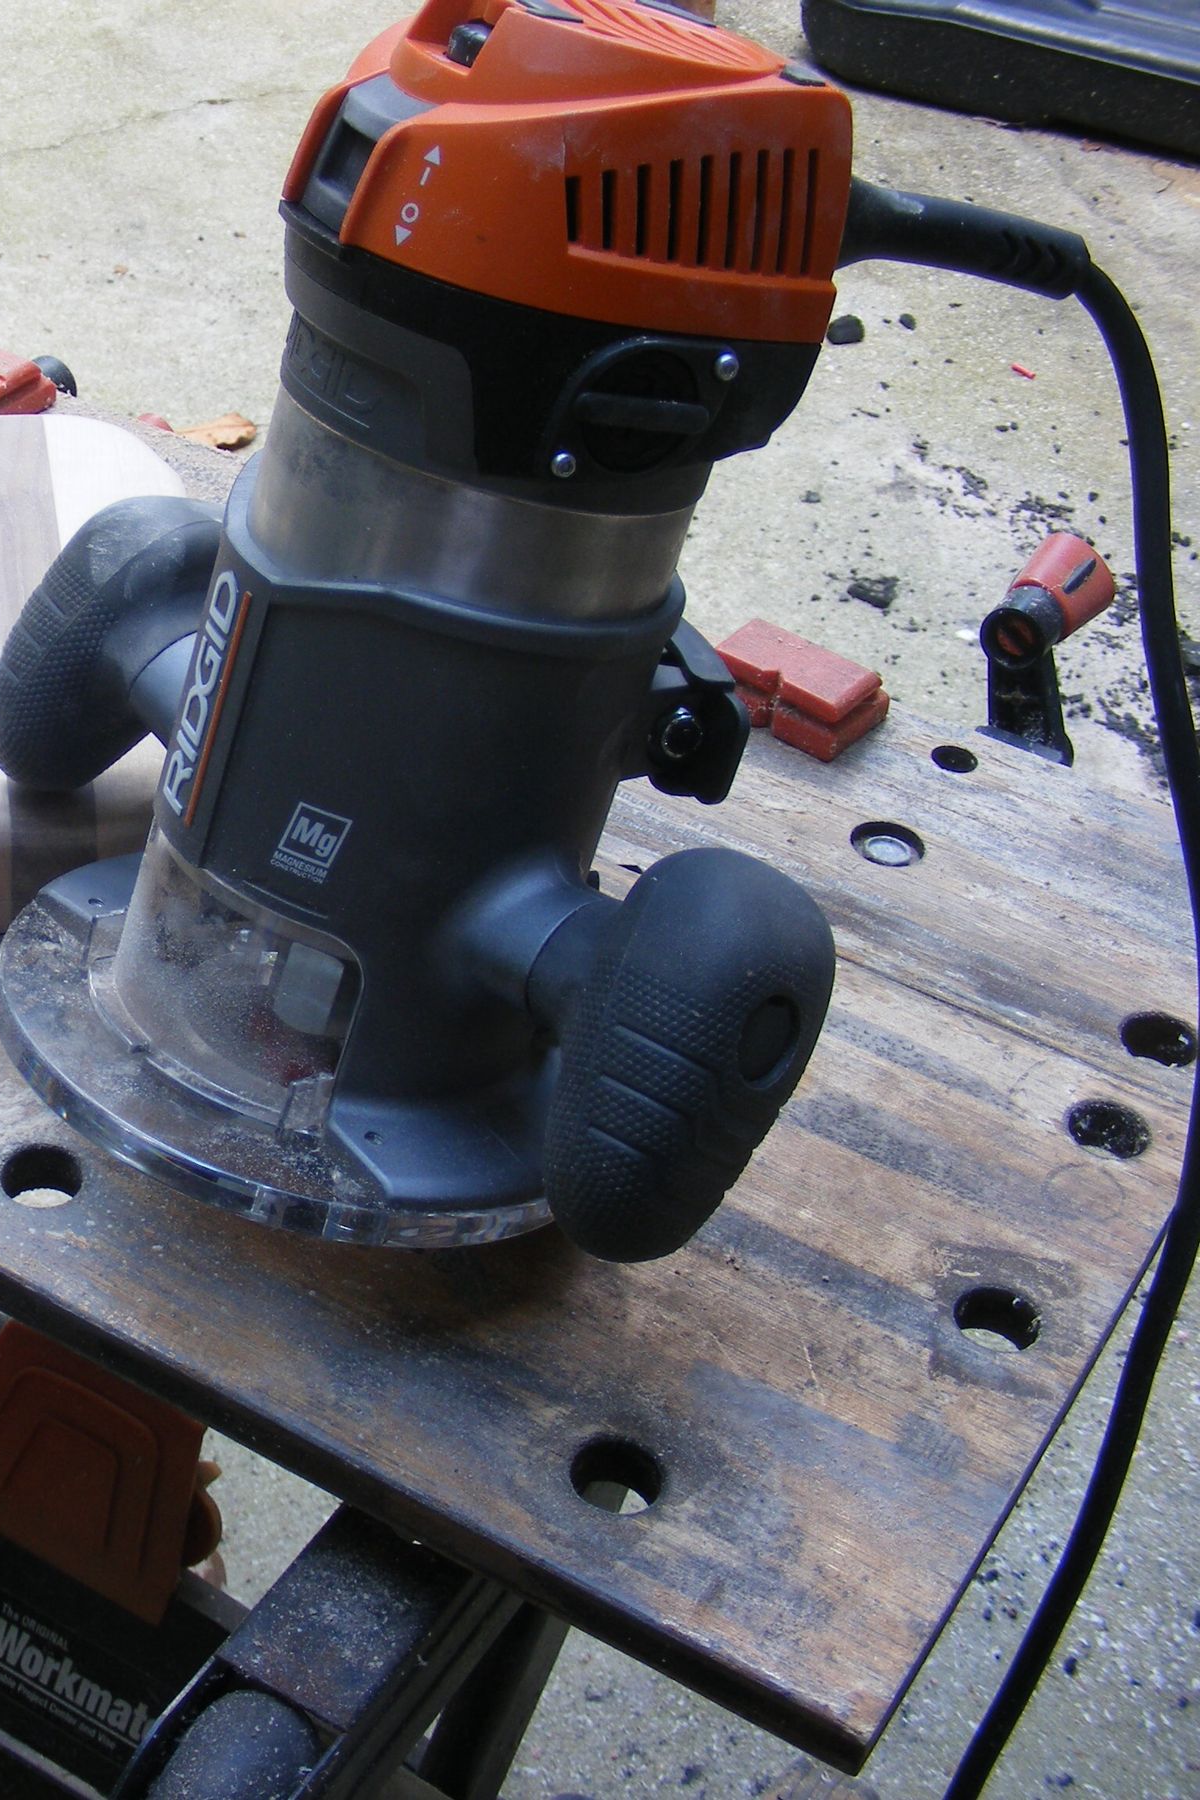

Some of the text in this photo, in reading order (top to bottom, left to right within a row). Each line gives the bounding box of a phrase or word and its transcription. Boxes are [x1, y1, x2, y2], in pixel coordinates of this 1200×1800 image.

[162, 570, 239, 816] RIDGID
[291, 816, 338, 857] Mg
[270, 858, 323, 884] CONSTRUCTION
[272, 850, 328, 878] MAGNESIUM
[1, 1601, 69, 1651] The ORIGINAL
